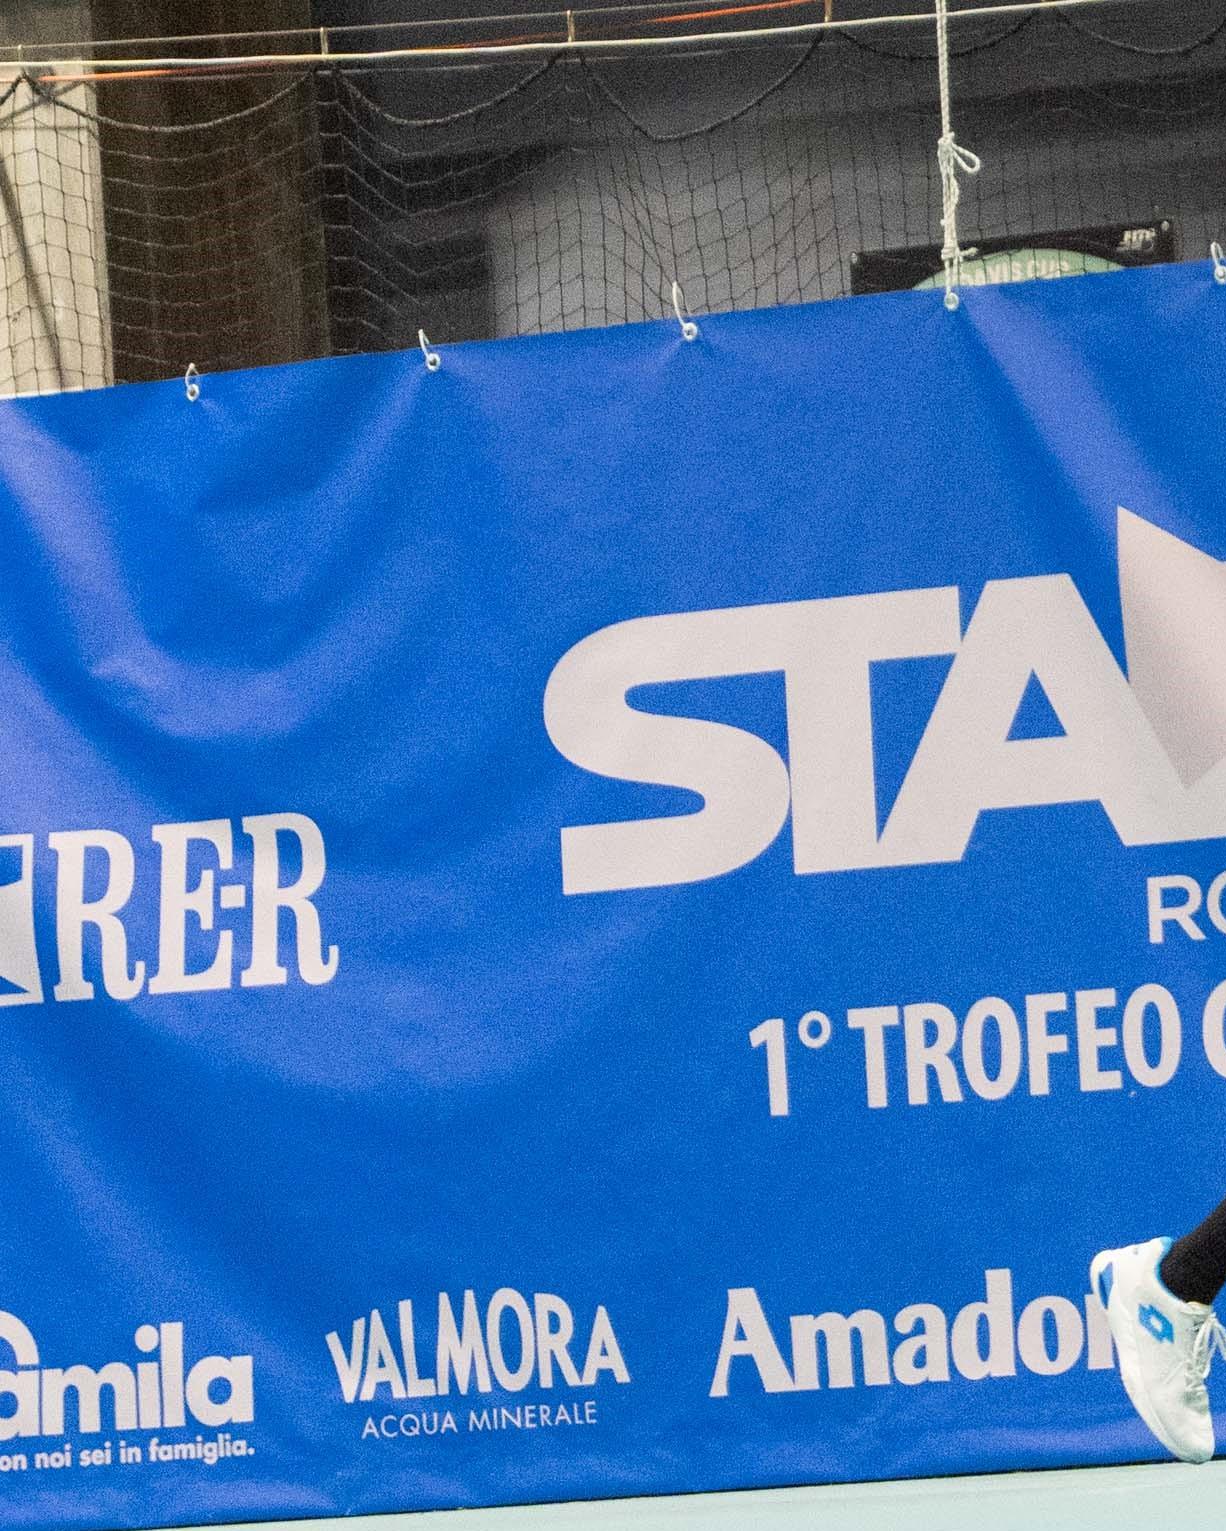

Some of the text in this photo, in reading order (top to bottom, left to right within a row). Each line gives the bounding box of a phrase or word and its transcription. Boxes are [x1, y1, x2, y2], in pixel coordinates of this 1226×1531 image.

[848, 983, 1182, 1108] TROFEO
[325, 1287, 631, 1404] VALMORA
[0, 1433, 256, 1472] on noi sei in famiglia.
[361, 1400, 598, 1440] ACQUA MINERALE
